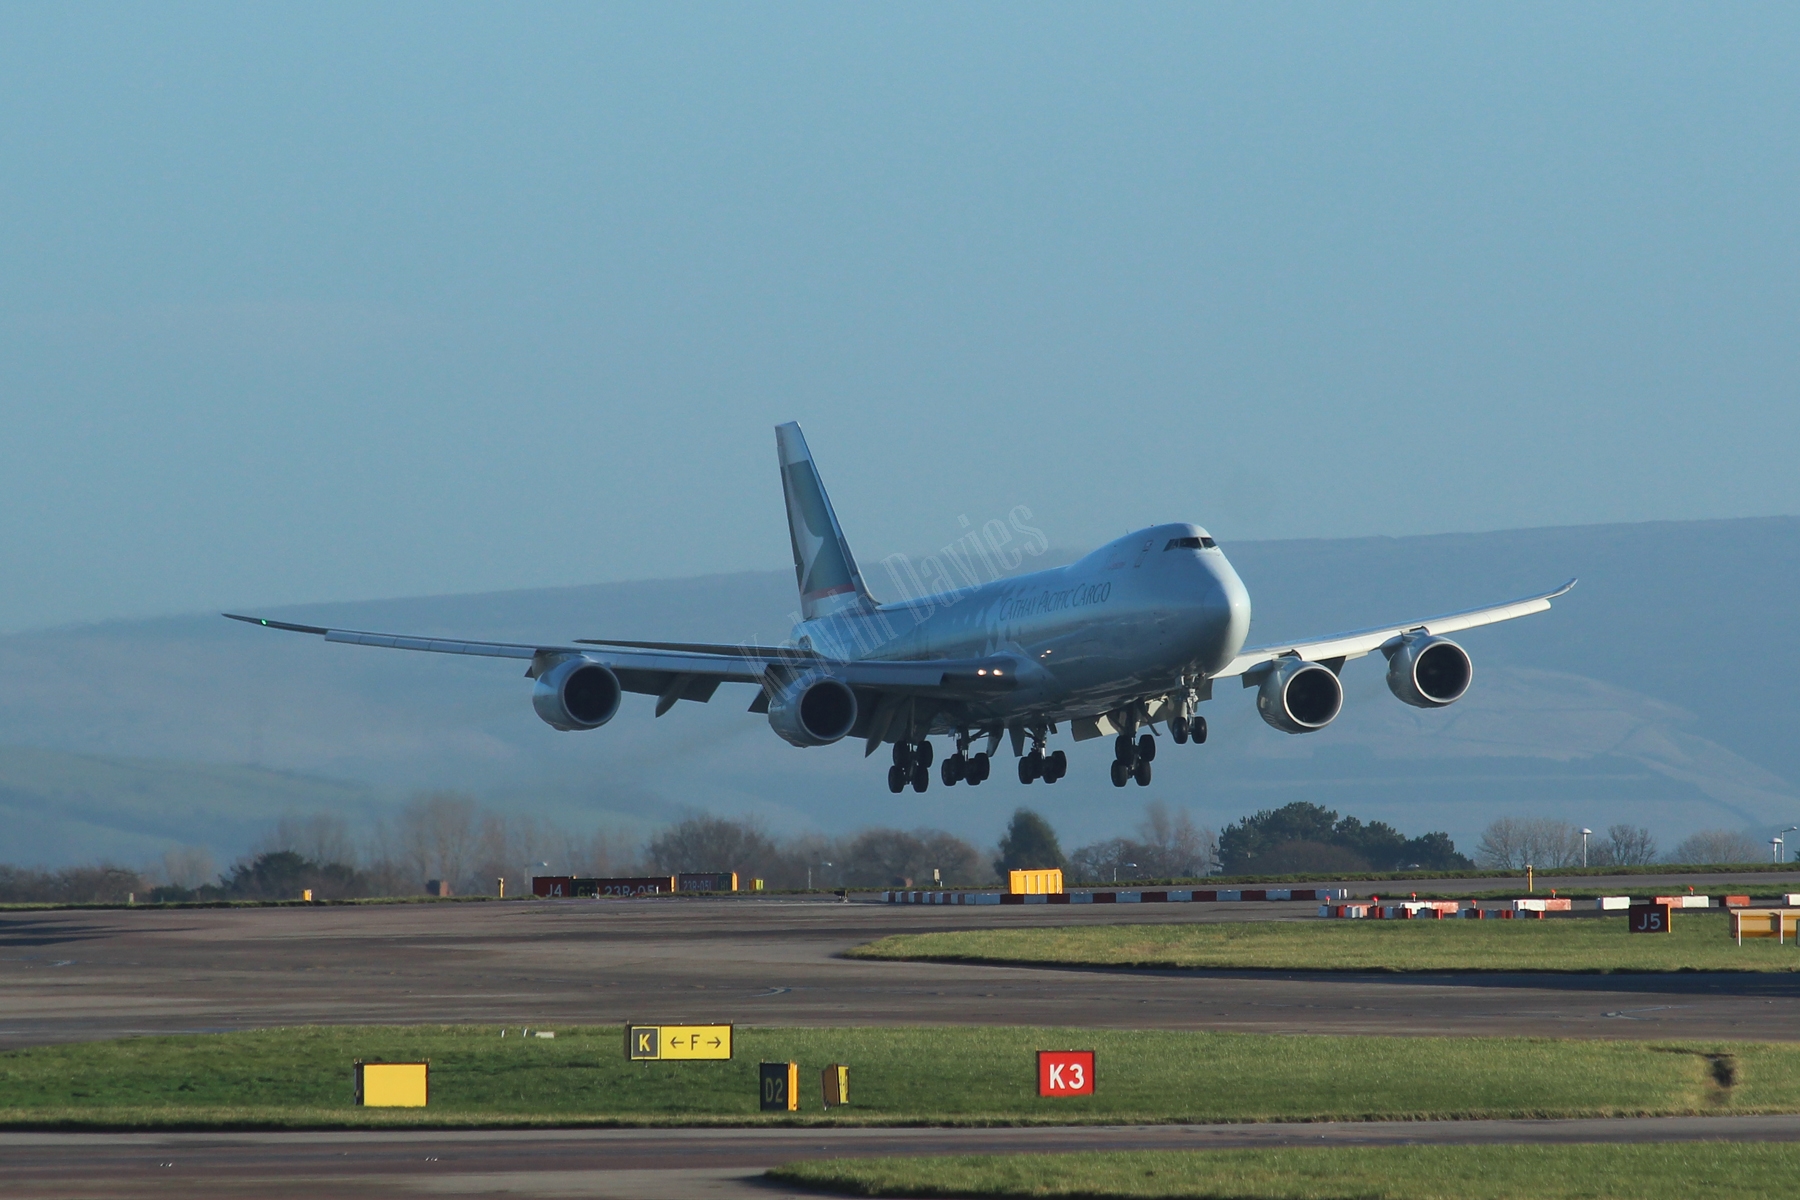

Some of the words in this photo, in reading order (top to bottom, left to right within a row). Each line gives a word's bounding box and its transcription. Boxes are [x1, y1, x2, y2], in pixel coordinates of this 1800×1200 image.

[1072, 581, 1111, 608] CARGO
[546, 883, 562, 898] J4
[604, 885, 659, 897] 23R-05
[1637, 913, 1661, 930] J5
[639, 1033, 651, 1052] K
[690, 1033, 701, 1051] F
[1049, 1063, 1085, 1090] K3
[765, 1077, 784, 1103] D2
